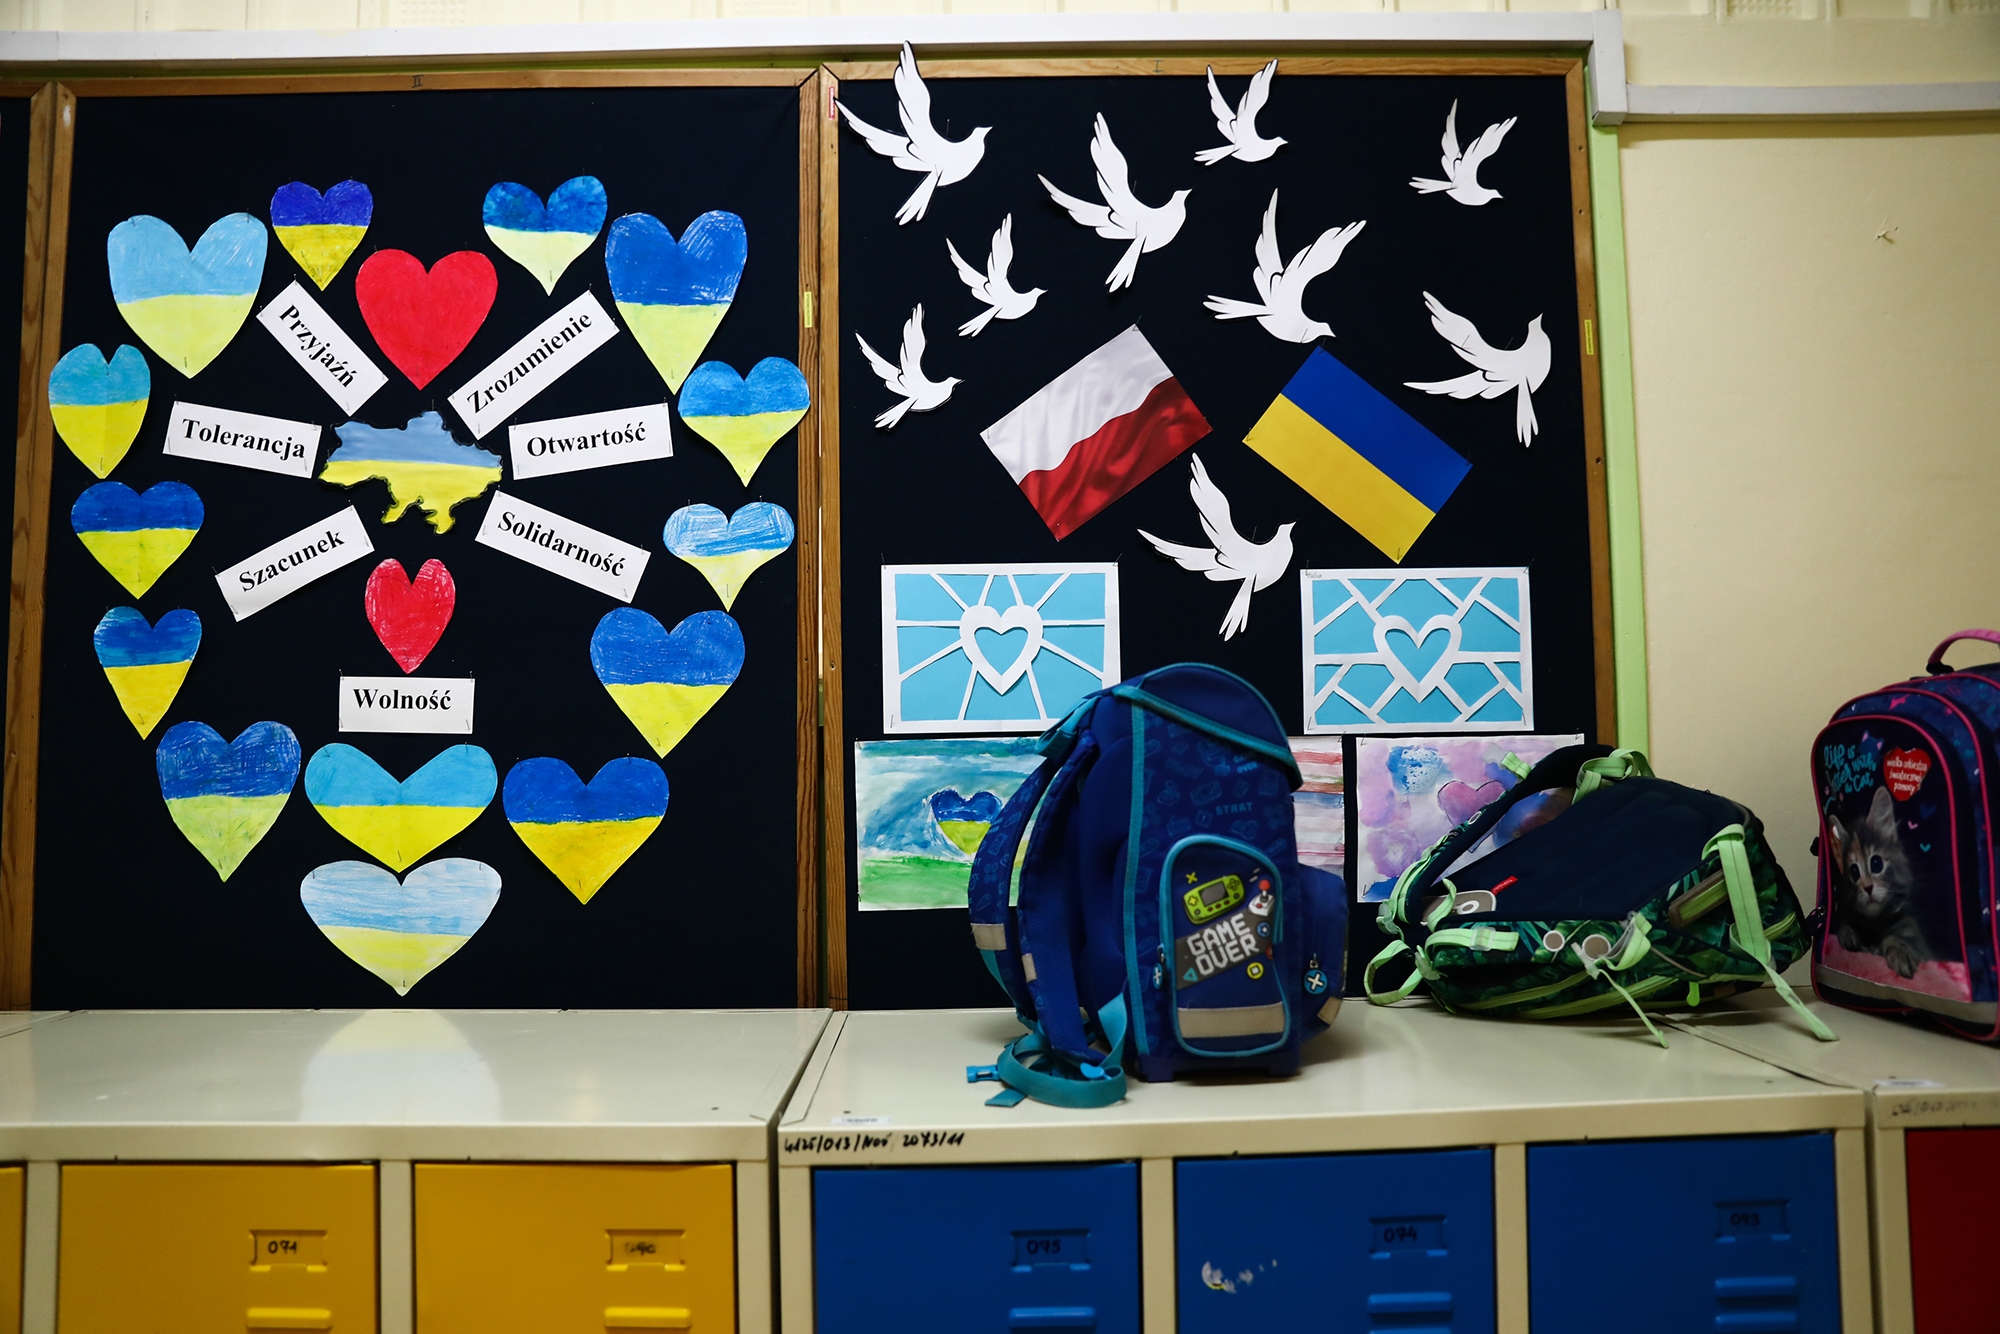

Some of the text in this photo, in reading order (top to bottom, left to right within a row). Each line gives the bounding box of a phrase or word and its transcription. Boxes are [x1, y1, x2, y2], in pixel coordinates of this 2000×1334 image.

[279, 304, 357, 388] Przyjaźń
[466, 314, 592, 414] Zrozumienie
[182, 418, 306, 461] Tolerancja
[527, 421, 647, 457] Otwartość
[239, 530, 345, 593] Szacunek
[497, 510, 626, 578] Solidarność
[353, 688, 452, 711] Wolność
[1186, 912, 1251, 957] GAME
[1195, 934, 1260, 976] OVER
